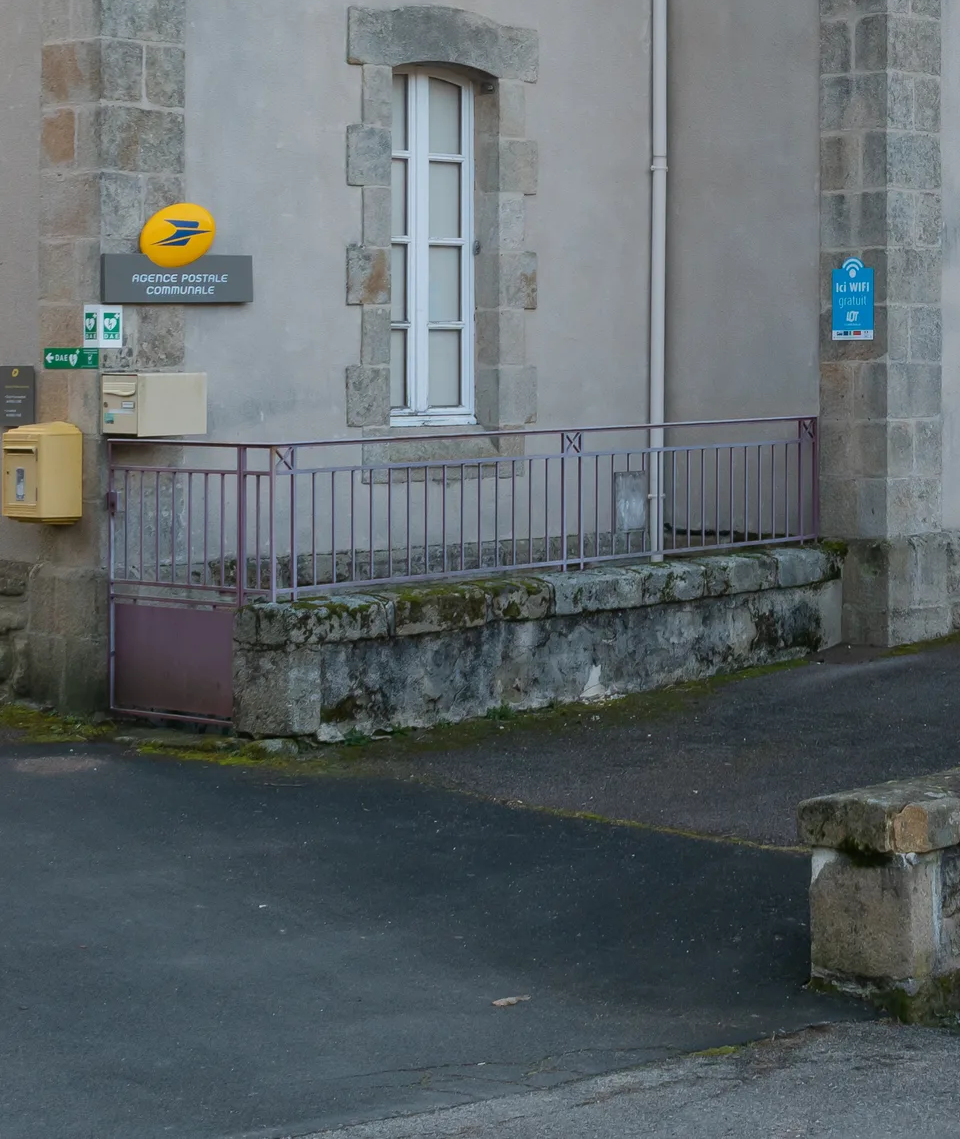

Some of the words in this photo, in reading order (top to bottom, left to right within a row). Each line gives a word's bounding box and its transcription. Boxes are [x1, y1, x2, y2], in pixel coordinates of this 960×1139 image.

[132, 273, 178, 283] AGENCE
[181, 273, 229, 283] POSTALE
[146, 285, 216, 295] COMMUNALE
[836, 281, 847, 292] Ici
[849, 282, 870, 292] WIFI
[838, 295, 867, 308] gratuit
[54, 354, 68, 362] DAE
